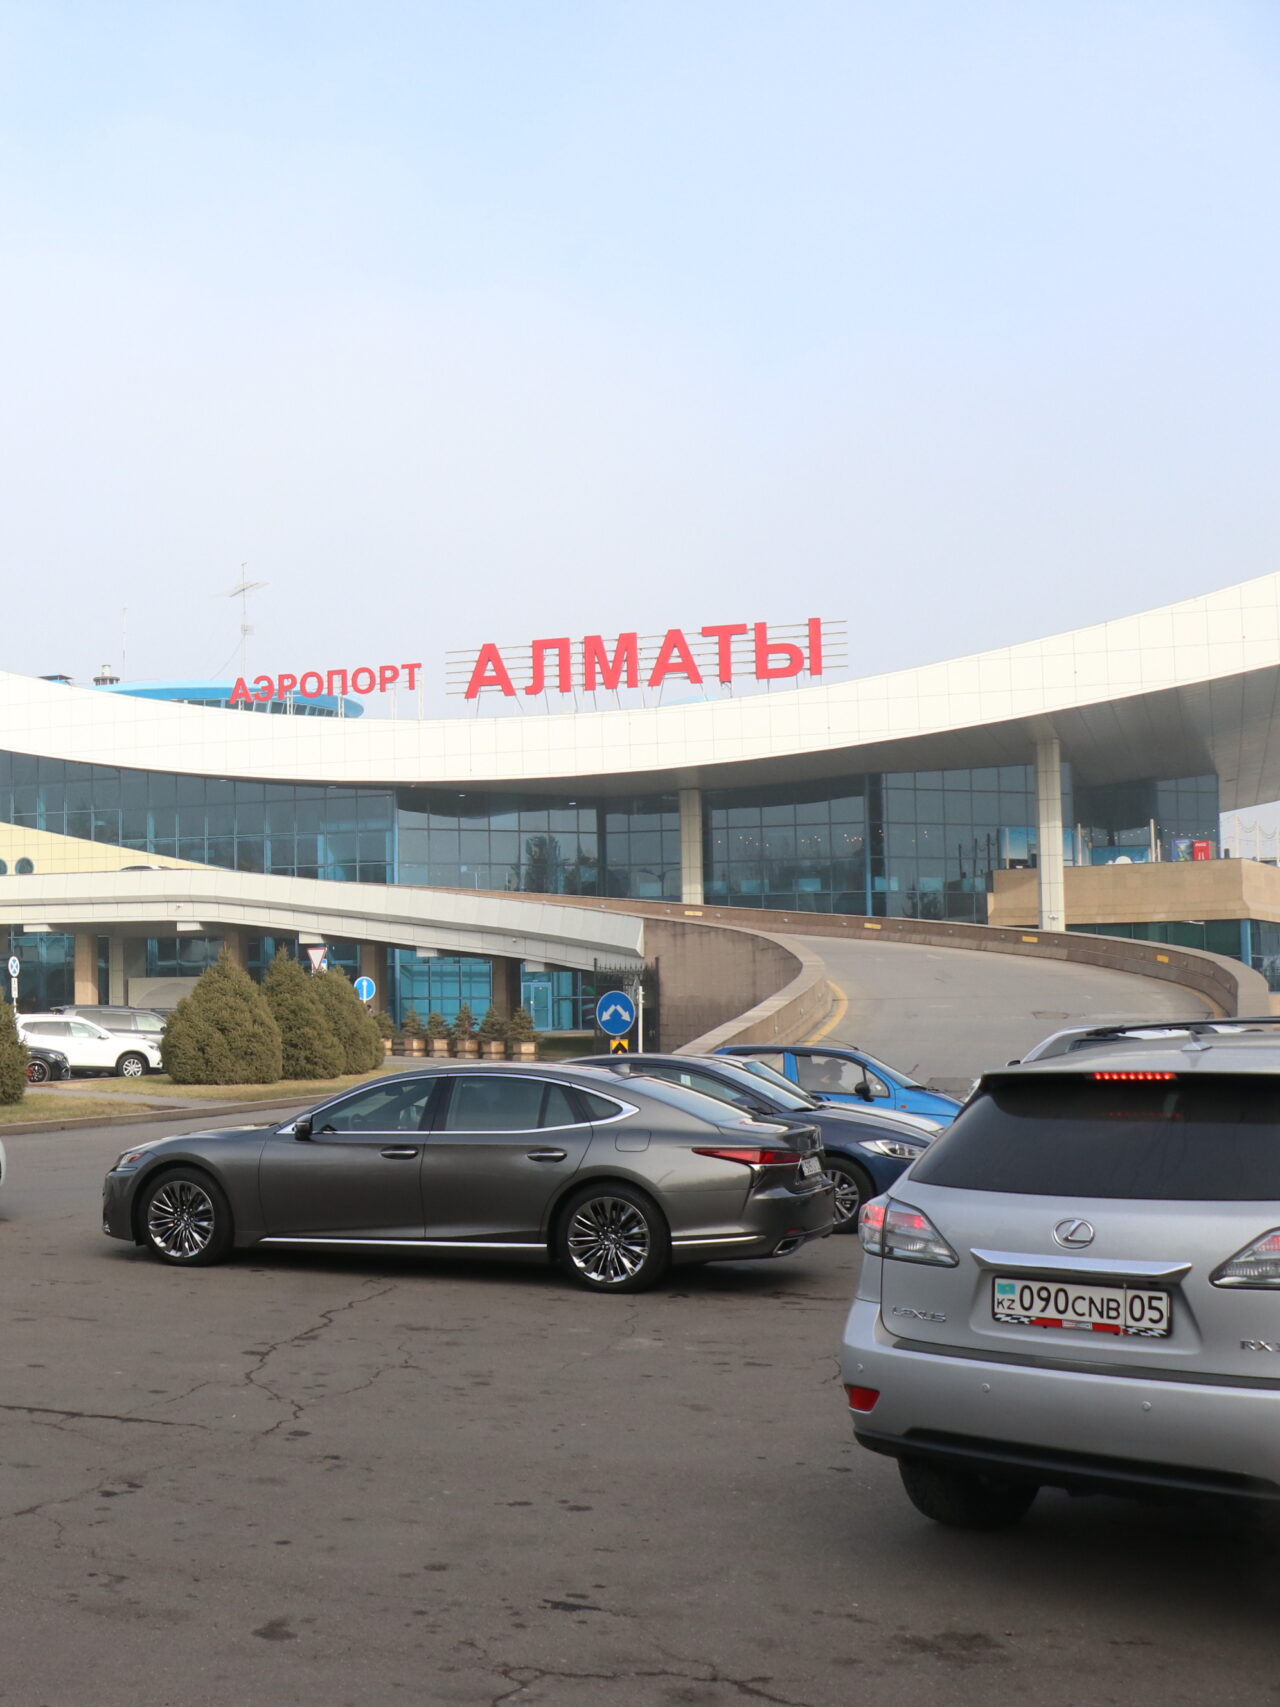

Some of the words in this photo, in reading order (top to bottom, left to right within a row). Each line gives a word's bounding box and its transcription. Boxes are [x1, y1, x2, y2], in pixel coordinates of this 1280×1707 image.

[229, 662, 422, 704] АЭРОПОРТ
[464, 617, 823, 699] АЛМАТЫ
[892, 1306, 946, 1323] LEXUS
[996, 1298, 1015, 1310] KZ
[1019, 1284, 1121, 1320] 090CNB
[1129, 1294, 1164, 1324] 05
[1240, 1338, 1272, 1352] RX
